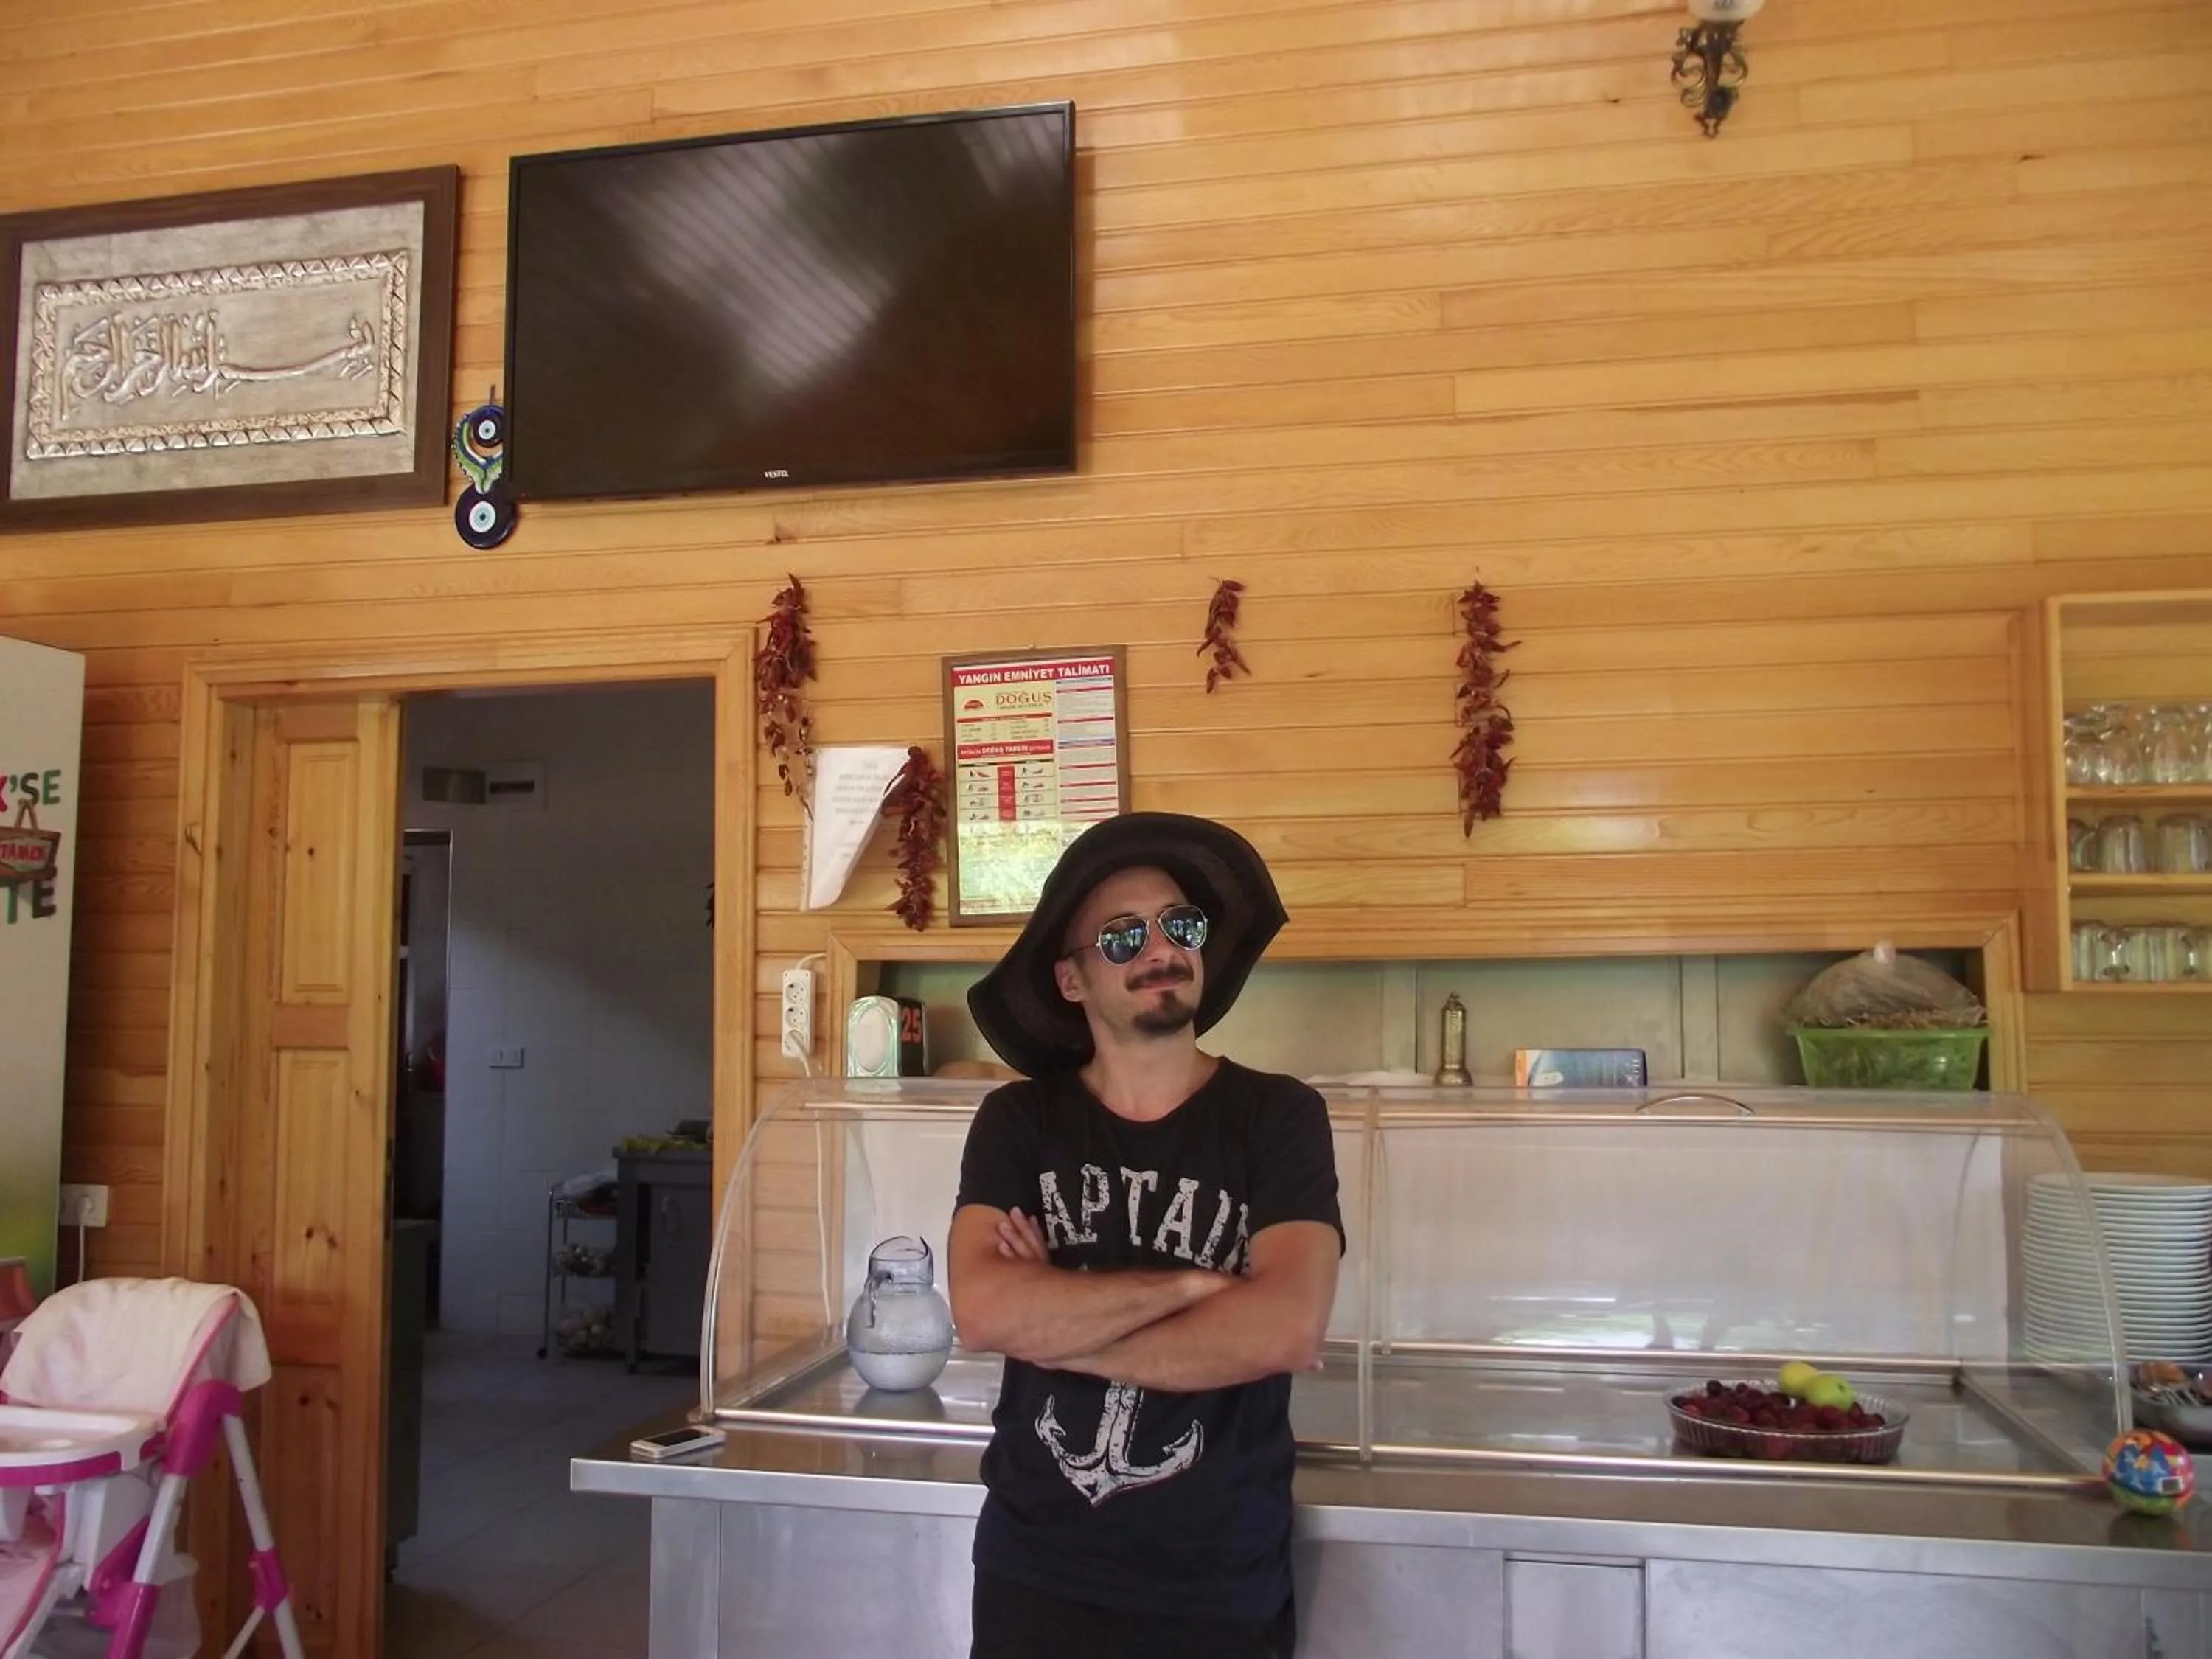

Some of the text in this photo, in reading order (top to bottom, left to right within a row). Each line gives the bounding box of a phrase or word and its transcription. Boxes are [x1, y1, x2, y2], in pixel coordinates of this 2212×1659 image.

[958, 672, 1001, 684] YANGIN
[1004, 668, 1054, 681] EMNİYET
[1058, 664, 1110, 677] TALİMATI
[995, 691, 1052, 706] DOĞUŞ
